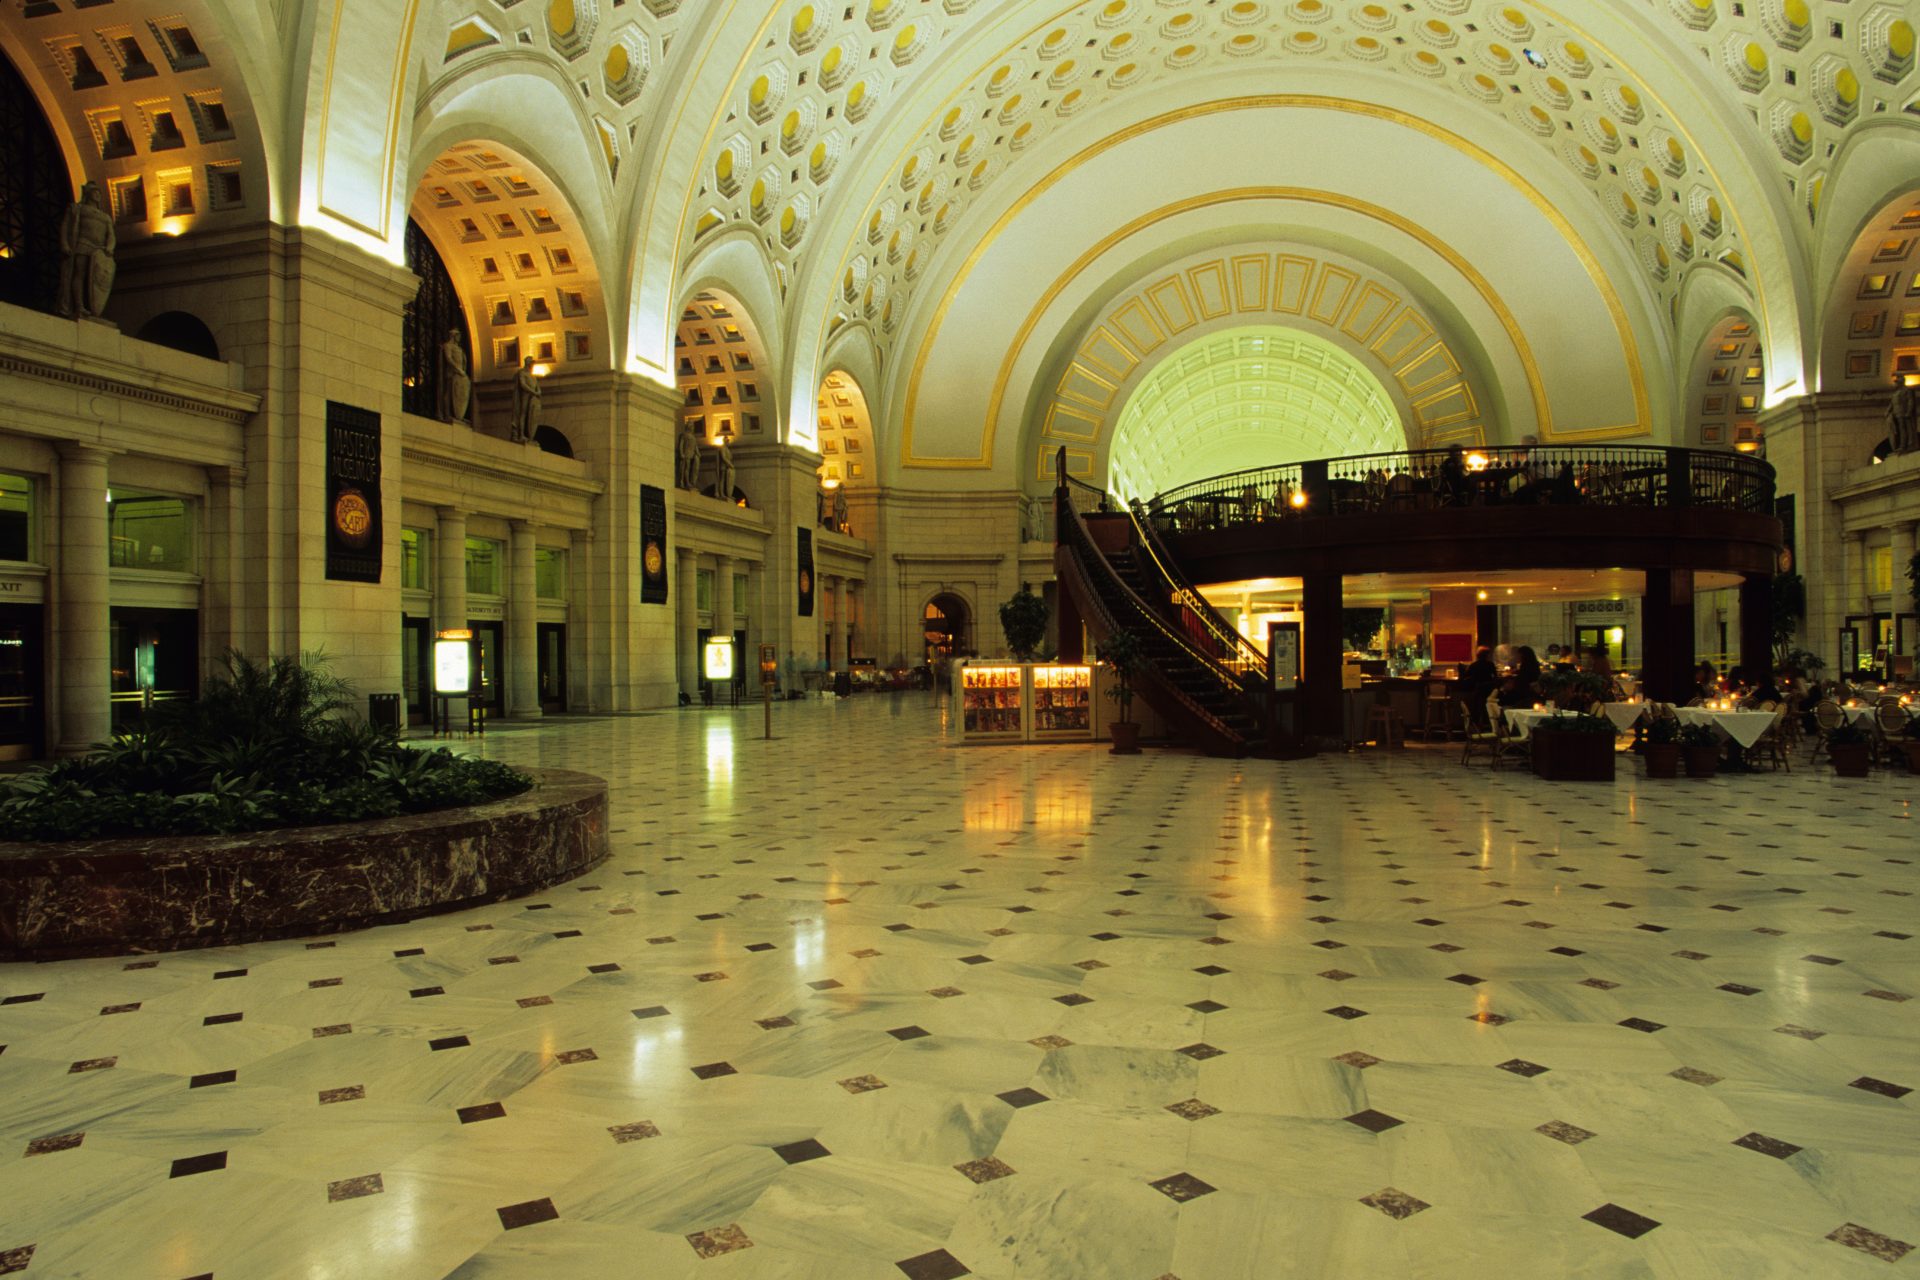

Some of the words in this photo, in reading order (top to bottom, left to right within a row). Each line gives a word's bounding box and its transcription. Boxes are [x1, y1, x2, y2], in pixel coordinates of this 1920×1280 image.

[332, 427, 376, 461] MASTERS
[332, 455, 365, 480] MUSEUM
[349, 515, 365, 531] ART
